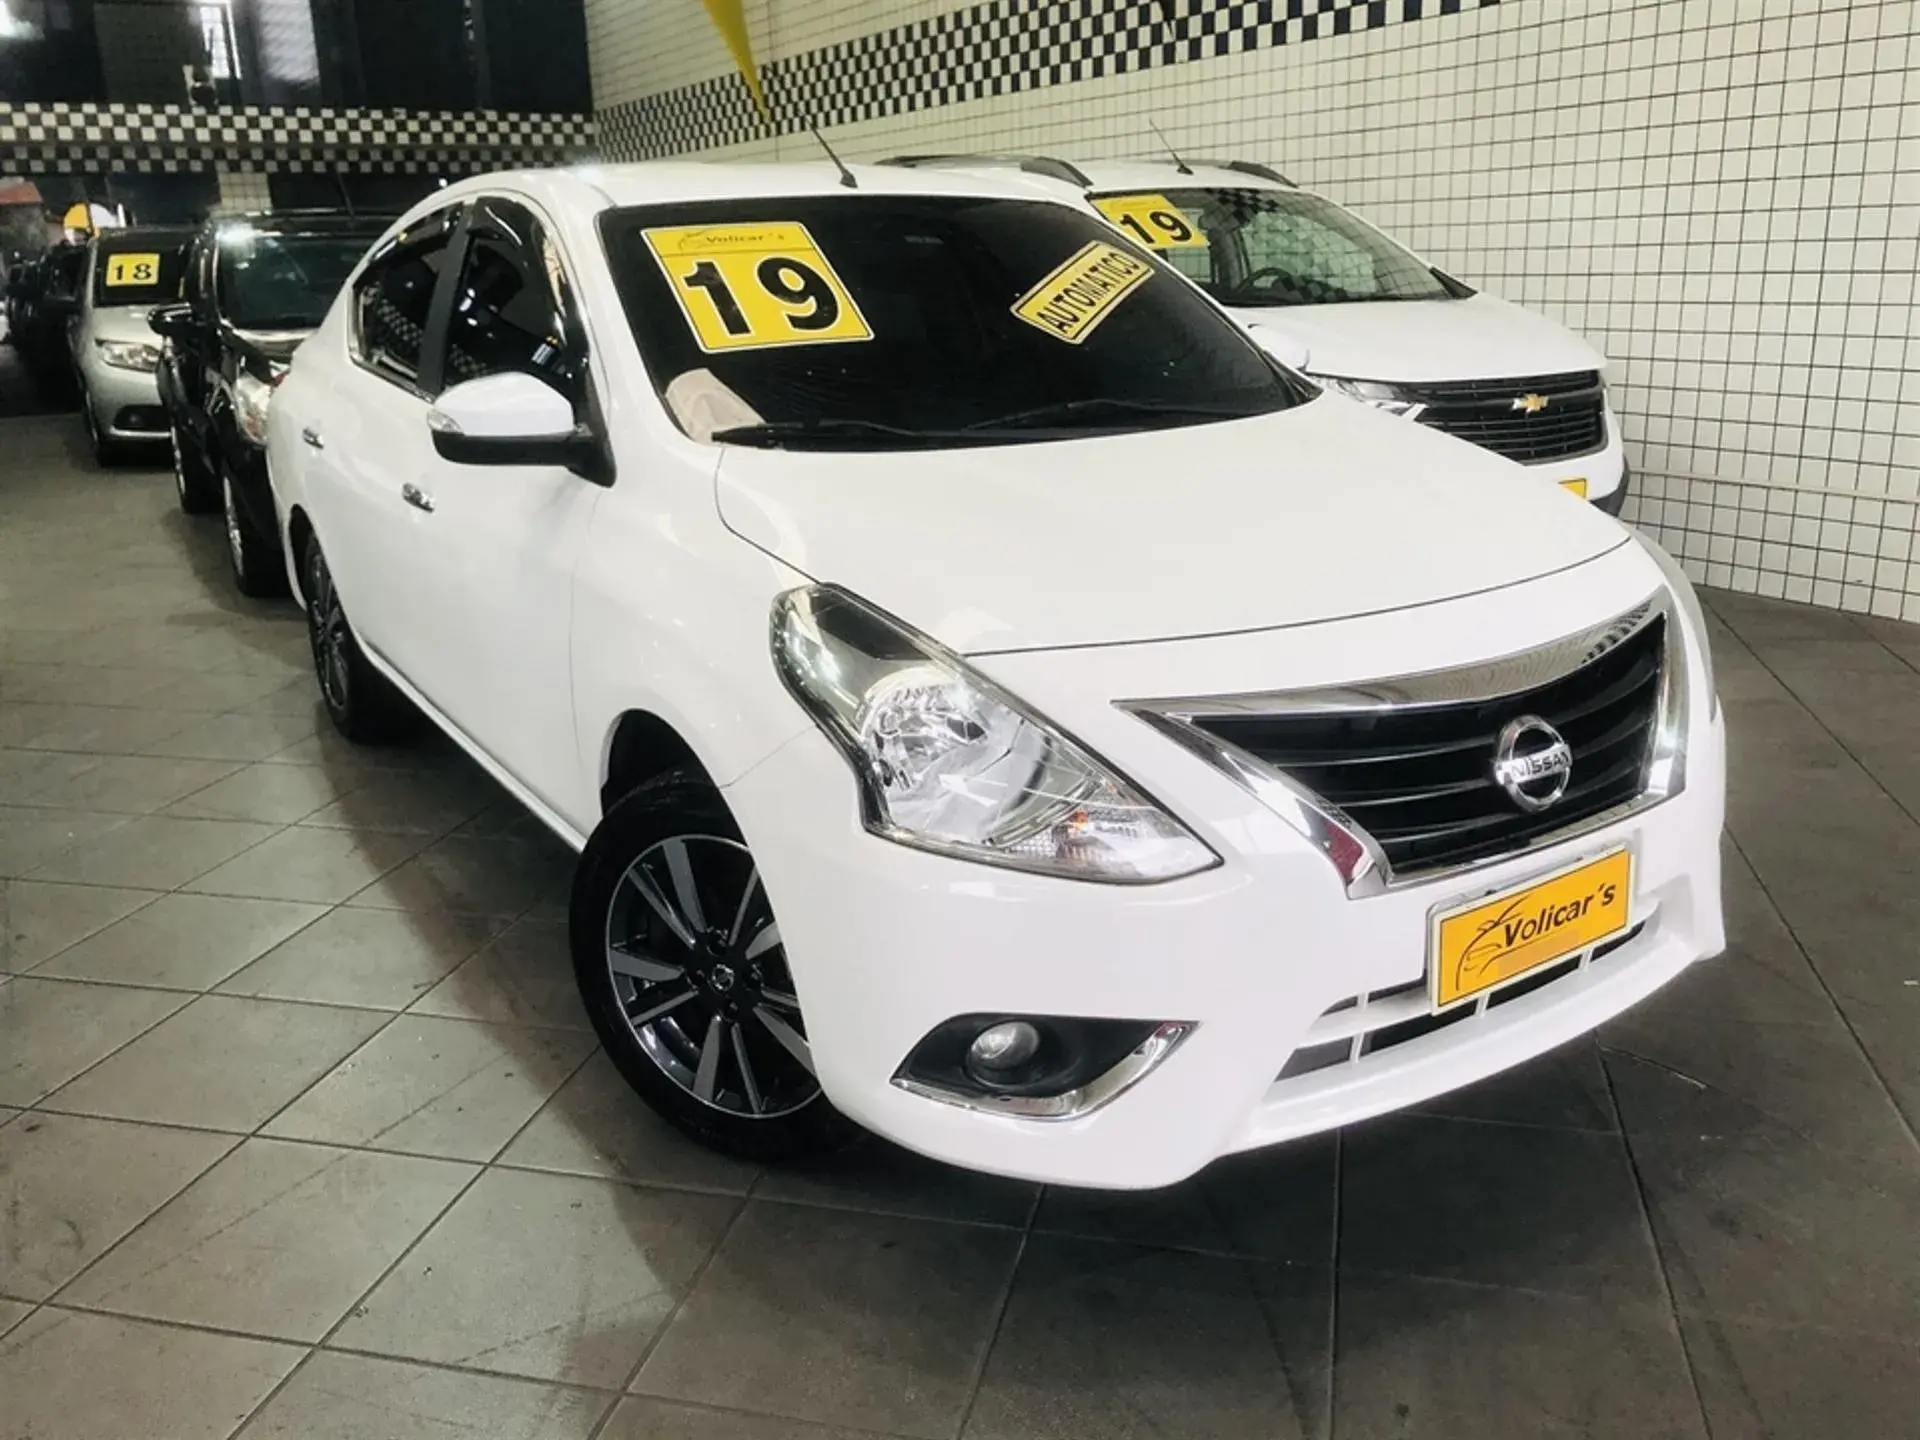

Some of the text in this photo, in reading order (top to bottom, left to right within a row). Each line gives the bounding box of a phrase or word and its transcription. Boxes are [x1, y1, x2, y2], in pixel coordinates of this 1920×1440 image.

[1119, 210, 1192, 243] 19
[115, 263, 152, 281] 18
[683, 256, 839, 335] 19
[1036, 251, 1141, 334] AUTOMATICO
[1511, 750, 1569, 777] NISSAN
